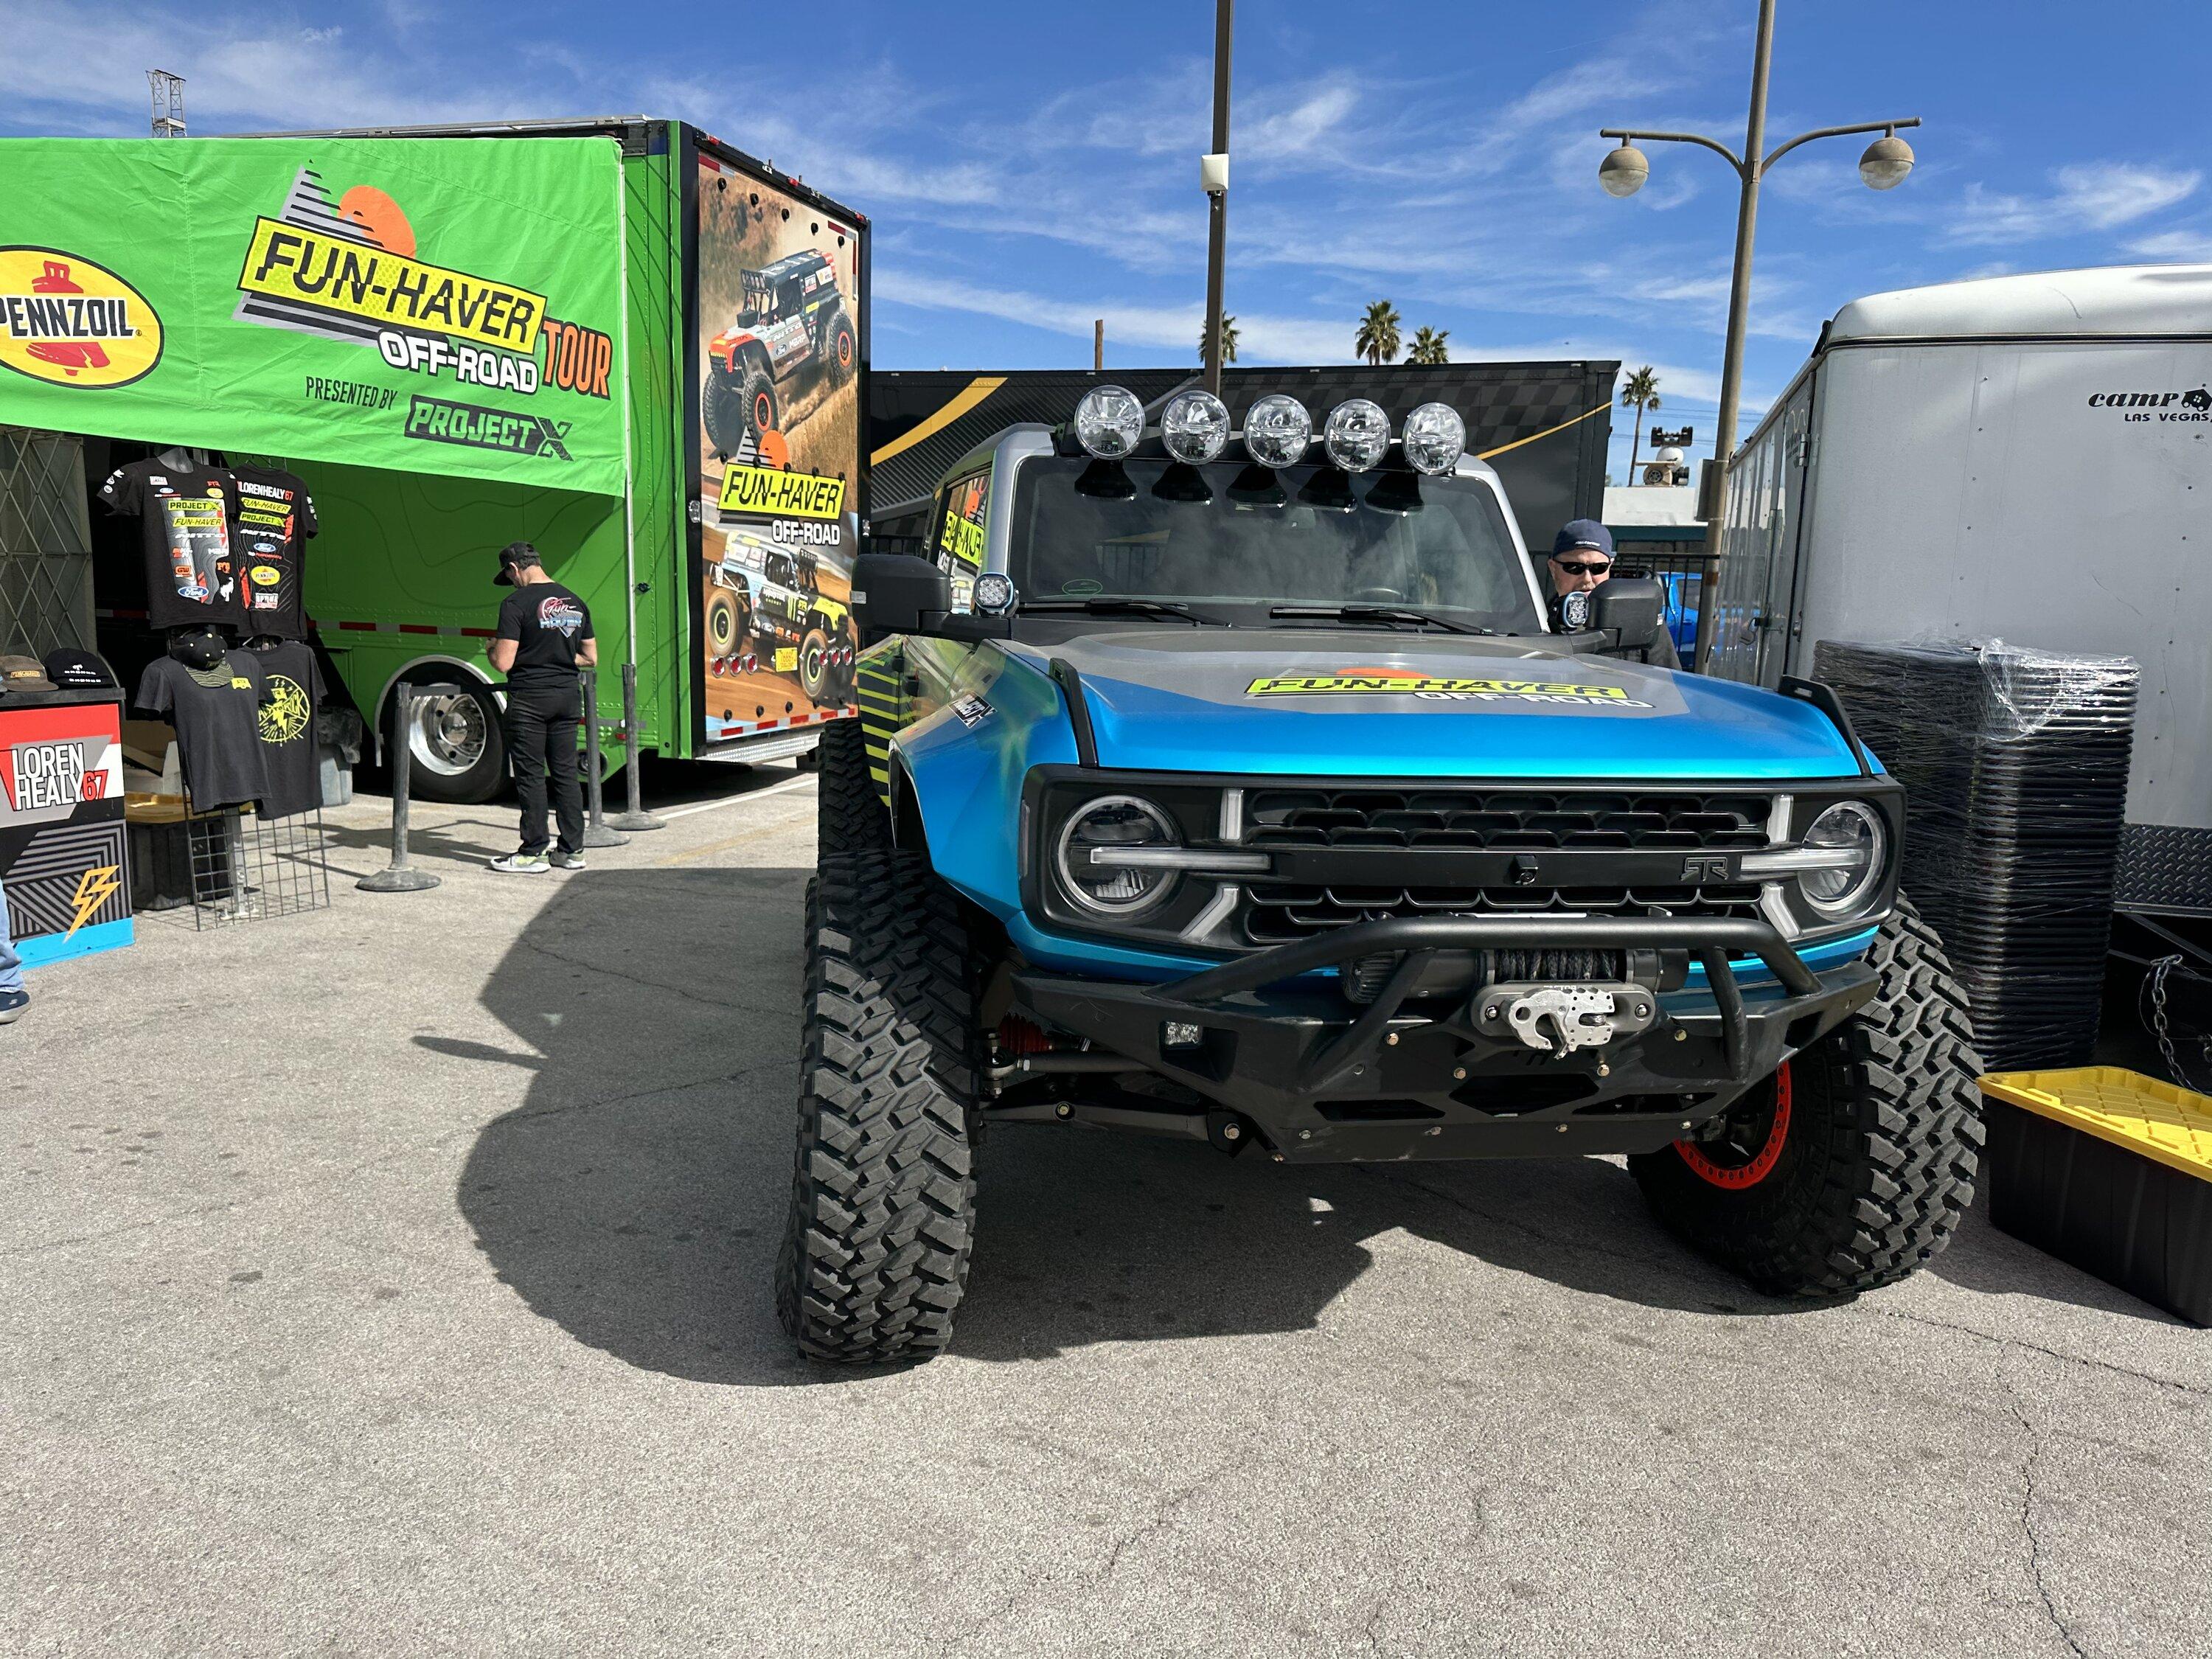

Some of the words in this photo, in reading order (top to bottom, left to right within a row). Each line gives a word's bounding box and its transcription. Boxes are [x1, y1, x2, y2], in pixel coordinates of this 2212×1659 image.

[255, 231, 535, 344] FUN-HAVER
[379, 331, 538, 394] OFF-ROAD
[541, 318, 612, 399] TOUR
[305, 376, 379, 407] PRESENTED
[378, 389, 398, 411] BY
[2088, 392, 2180, 408] camp
[2124, 413, 2151, 422] LAS
[724, 471, 841, 514] FUN-HAVER
[170, 502, 208, 510] PROJECT
[175, 518, 222, 526] FUN-HAVER
[241, 513, 275, 524] PROJECT
[772, 519, 841, 546] OFF-ROAD
[1259, 678, 1613, 697] FUN-HAVER
[1413, 692, 1656, 708] OFF-ROAD
[11, 742, 85, 779] LOREN
